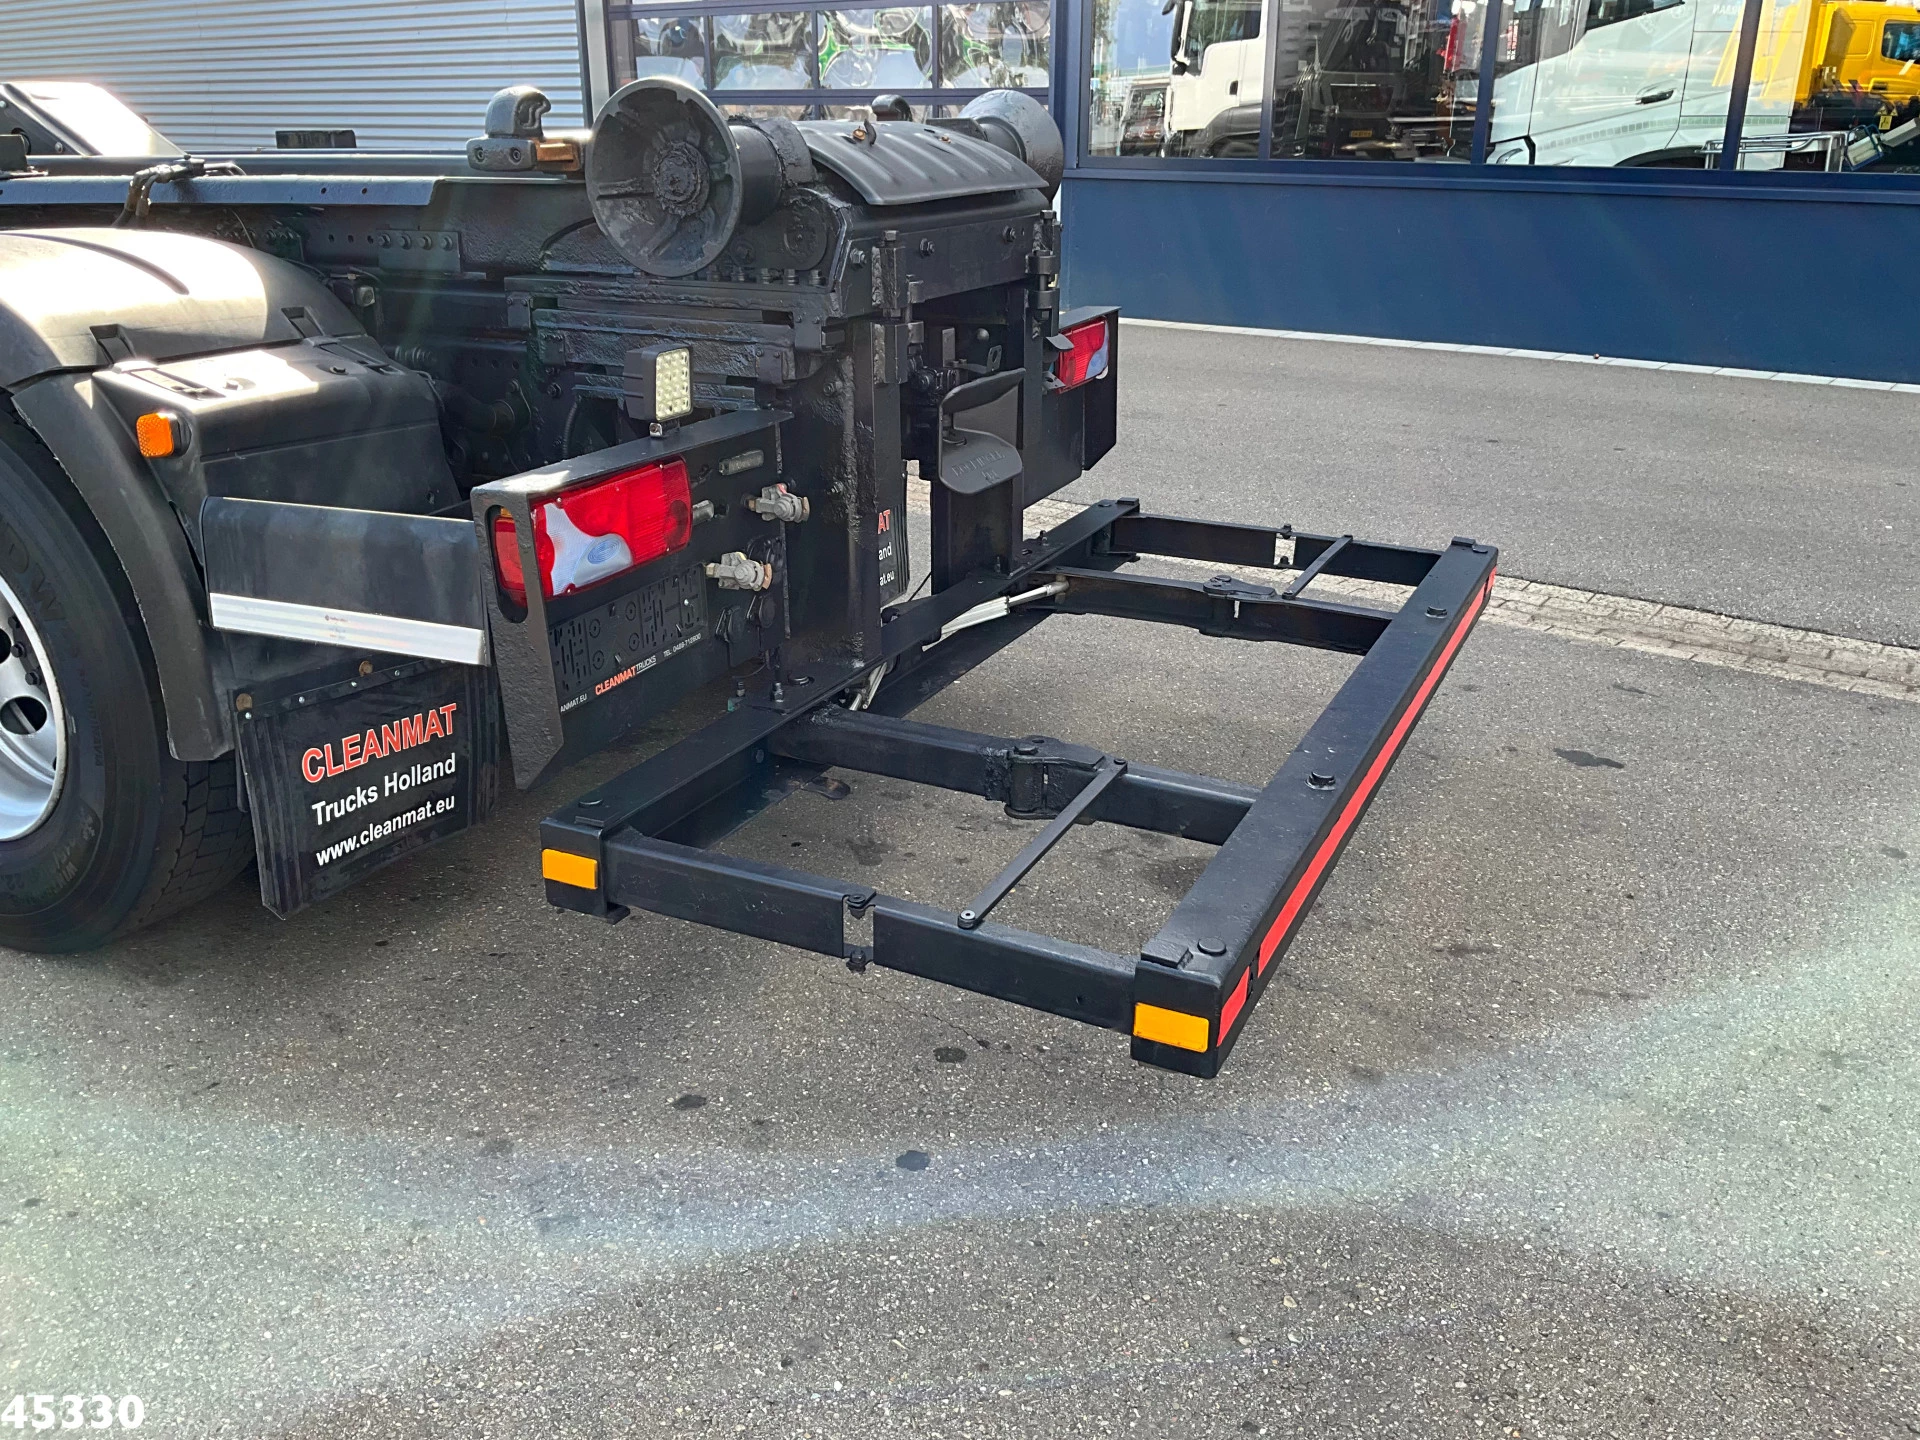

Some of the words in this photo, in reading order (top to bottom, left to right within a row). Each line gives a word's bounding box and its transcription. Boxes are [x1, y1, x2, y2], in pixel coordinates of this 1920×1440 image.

[302, 703, 457, 783] CLEANMAT
[312, 786, 378, 825] Trucks
[384, 752, 456, 797] Holland
[316, 796, 455, 866] www.cleanmat.eu
